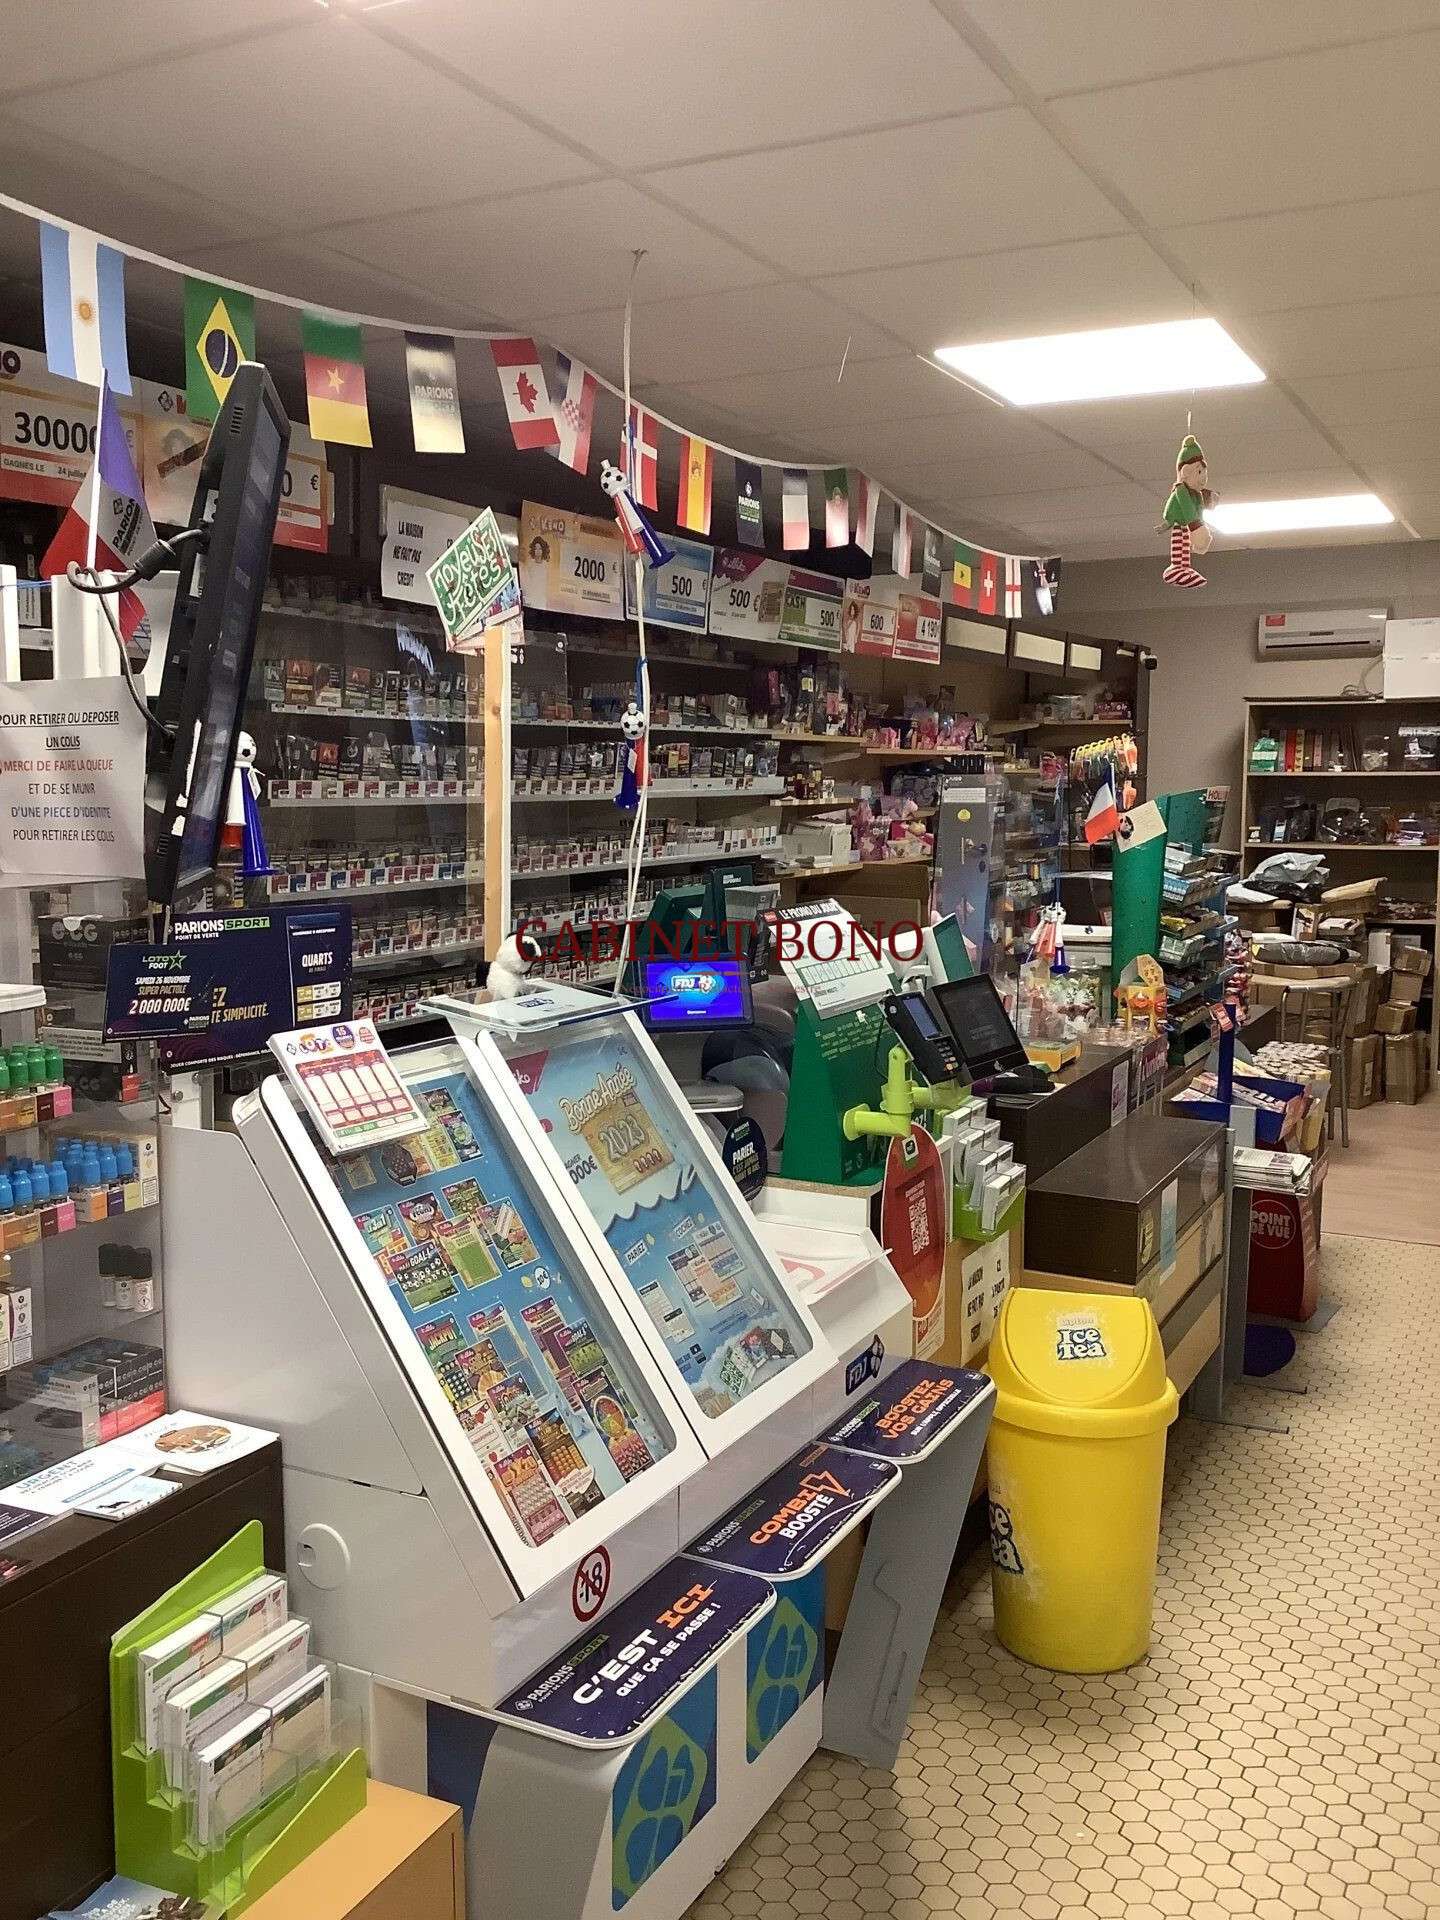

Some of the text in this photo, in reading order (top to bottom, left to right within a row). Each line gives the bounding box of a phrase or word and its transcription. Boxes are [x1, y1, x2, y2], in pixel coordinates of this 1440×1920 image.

[414, 385, 454, 400] PARIONS
[574, 555, 605, 582] 2000
[671, 574, 692, 597] 500
[729, 588, 750, 609] 500
[820, 609, 834, 626] 500
[870, 615, 883, 630] 600
[29, 712, 66, 725] RETIRER
[67, 711, 81, 724] OU
[81, 710, 119, 723] DEPOSER
[46, 735, 80, 748] UN COLIS
[4, 759, 113, 772] MERCI DE FAIRE LA QUEUE
[28, 783, 95, 795] ET DE SE MUNIR
[11, 807, 41, 818] D'UNE
[43, 807, 71, 818] PIECE
[13, 829, 115, 842] POUR RETIRER LES COLIS
[778, 909, 790, 919] LE
[174, 917, 270, 935] PARIONS SPORT
[175, 933, 193, 941] POINT
[202, 931, 219, 939] VENTE
[143, 955, 169, 963] LOTO
[148, 962, 168, 970] FOOT
[302, 952, 333, 967] QUARTS
[135, 976, 155, 985] SAMEDI
[163, 975, 191, 984] NOVEMBRE
[674, 979, 695, 989] FDJ
[138, 984, 187, 996] SUPER PACTOLE
[129, 1000, 138, 1014] 2
[139, 999, 165, 1014] 000
[559, 1062, 637, 1135] Bonne Année
[599, 1114, 647, 1163] 2023
[1252, 1210, 1291, 1226] POINT
[1250, 1221, 1290, 1239] DE VUE
[627, 1241, 647, 1264] PARIEZ
[875, 1379, 937, 1430] BOOSTEZ
[882, 1414, 916, 1440] VOS
[911, 1378, 955, 1416] GAINS
[749, 1489, 818, 1545] COMBI
[708, 1520, 741, 1548] PARIONS
[572, 1583, 714, 1705] C'EST ICI
[616, 1669, 646, 1698] QUE
[643, 1653, 665, 1674] ÇA
[660, 1638, 680, 1657] SE
[674, 1607, 716, 1642] PASSE
[527, 1663, 574, 1701] PARIONS
